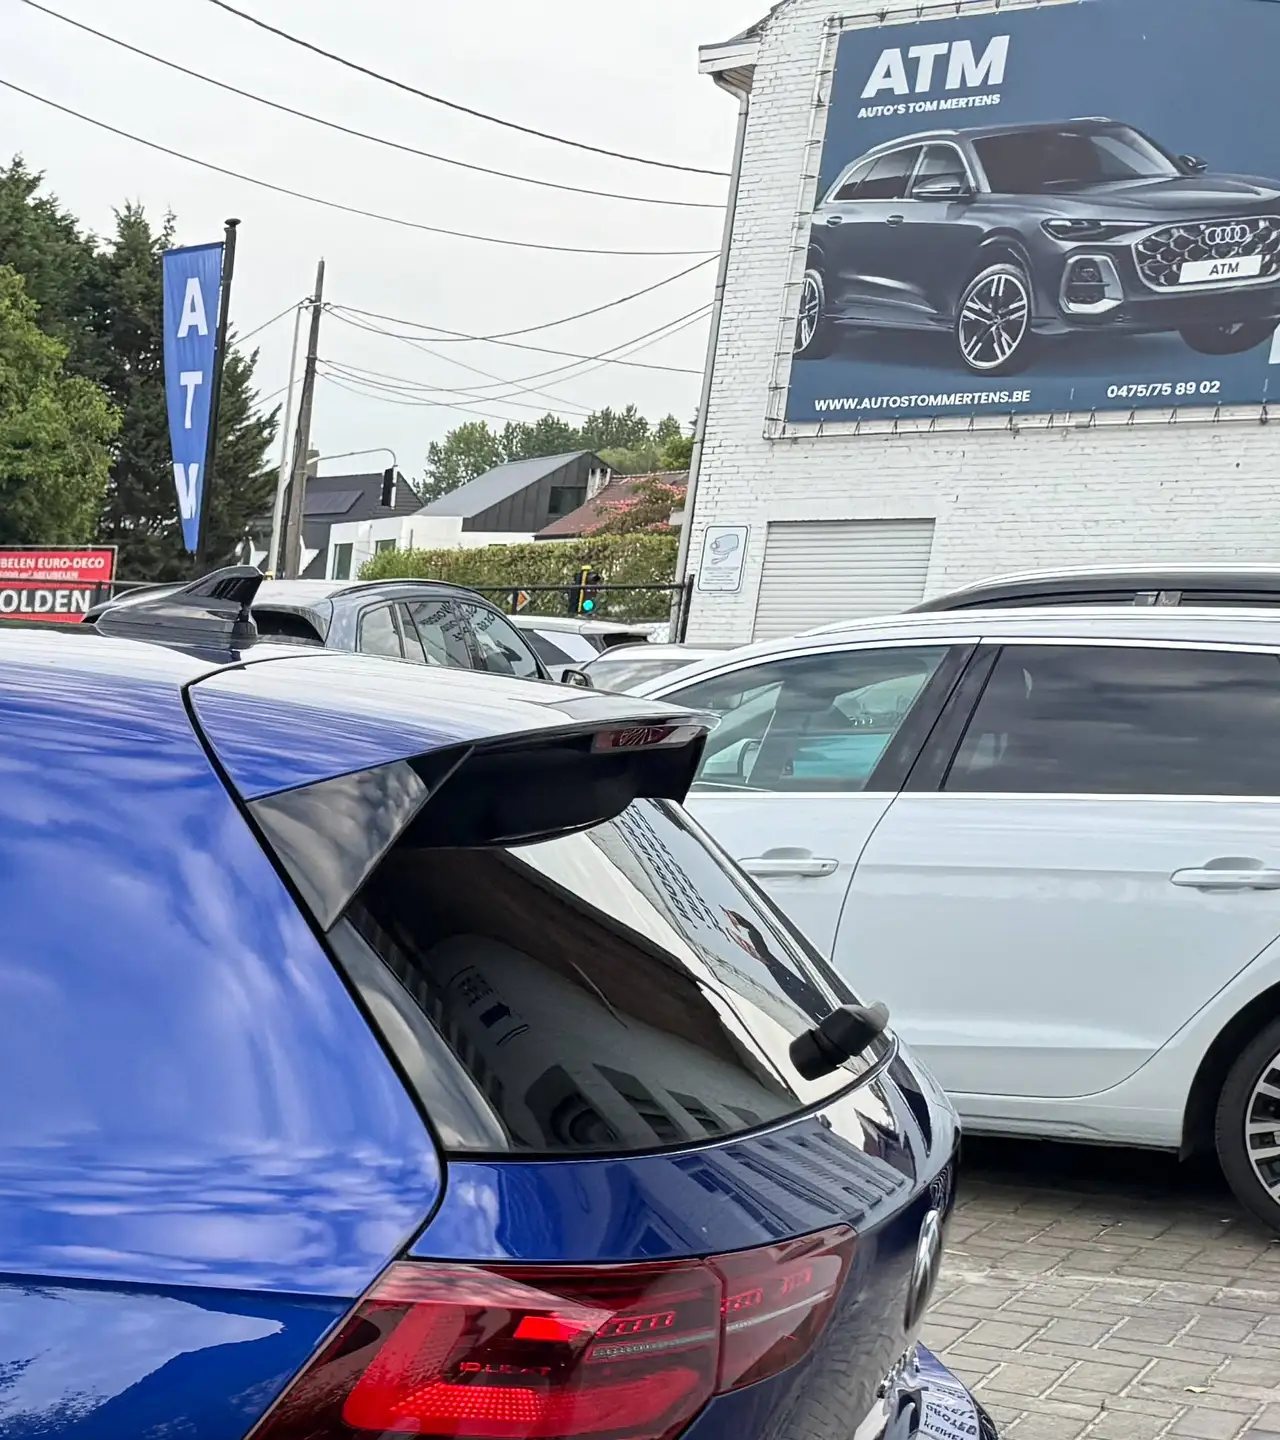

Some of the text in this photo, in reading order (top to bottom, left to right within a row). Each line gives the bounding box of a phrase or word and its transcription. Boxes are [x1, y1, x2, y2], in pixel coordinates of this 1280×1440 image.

[860, 35, 1011, 99] ATM
[908, 100, 938, 114] TOM
[939, 93, 1001, 111] MERTENS
[1208, 261, 1240, 276] ATM
[1106, 380, 1221, 398] 0475/75 89 02
[814, 390, 1031, 411] WWW.AUTOSTOMMERTENS.BE
[37, 557, 105, 569] EURO-DECO
